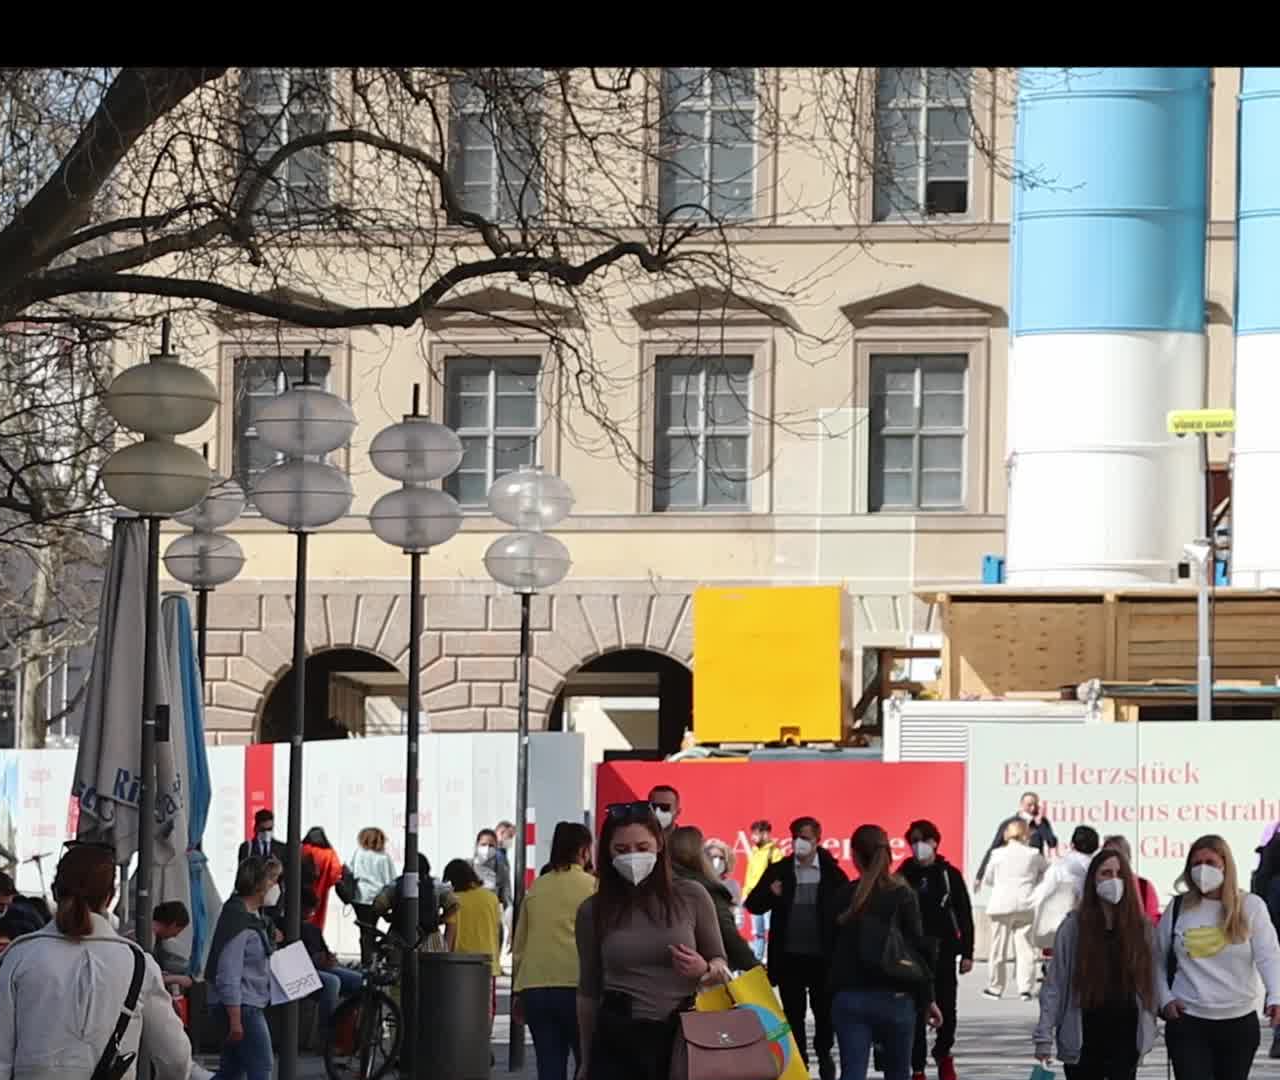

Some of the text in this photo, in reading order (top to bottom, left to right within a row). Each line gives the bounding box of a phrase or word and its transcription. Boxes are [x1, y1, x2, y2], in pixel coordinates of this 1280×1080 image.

[1003, 761, 1200, 785] Ein Herzstück
[1177, 799, 1280, 822] erstrah
[1140, 835, 1191, 859] Gla
